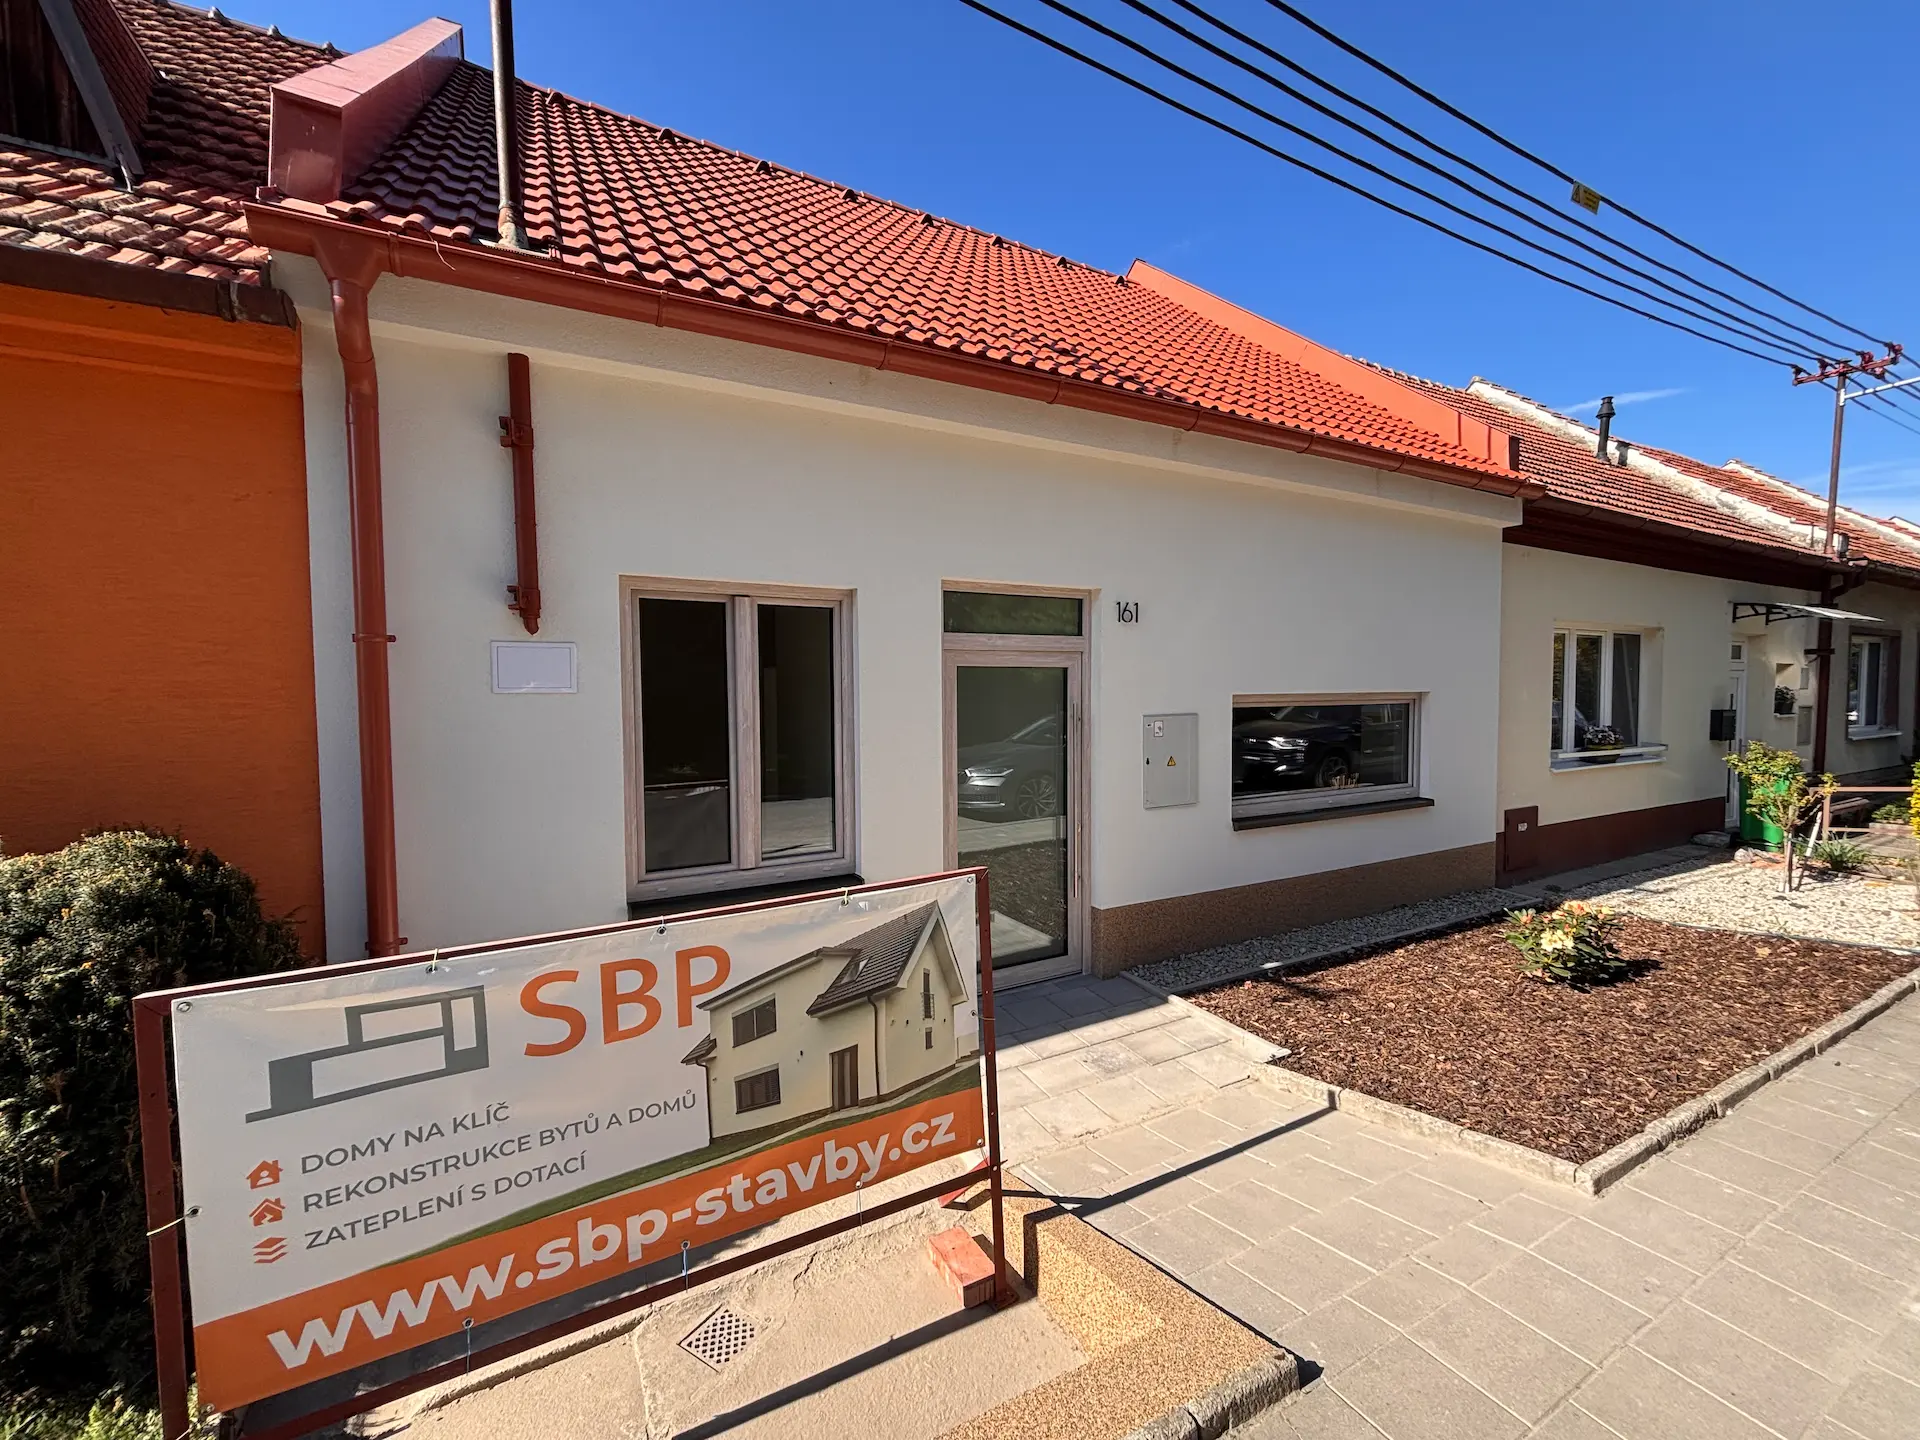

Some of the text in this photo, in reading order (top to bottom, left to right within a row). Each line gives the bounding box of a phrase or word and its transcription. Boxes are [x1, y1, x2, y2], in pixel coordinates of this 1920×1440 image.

[1115, 601, 1139, 623] 161
[520, 945, 731, 1057] SBP
[301, 1101, 510, 1174] DOMY NA KLÍČ
[303, 1089, 697, 1212] REKONSTRUKCE BYTŮ A DOMŮ
[267, 1110, 957, 1369] www.sbp-stavby.cz
[305, 1150, 587, 1250] ZATEPLENÍ S DOTACÍ
